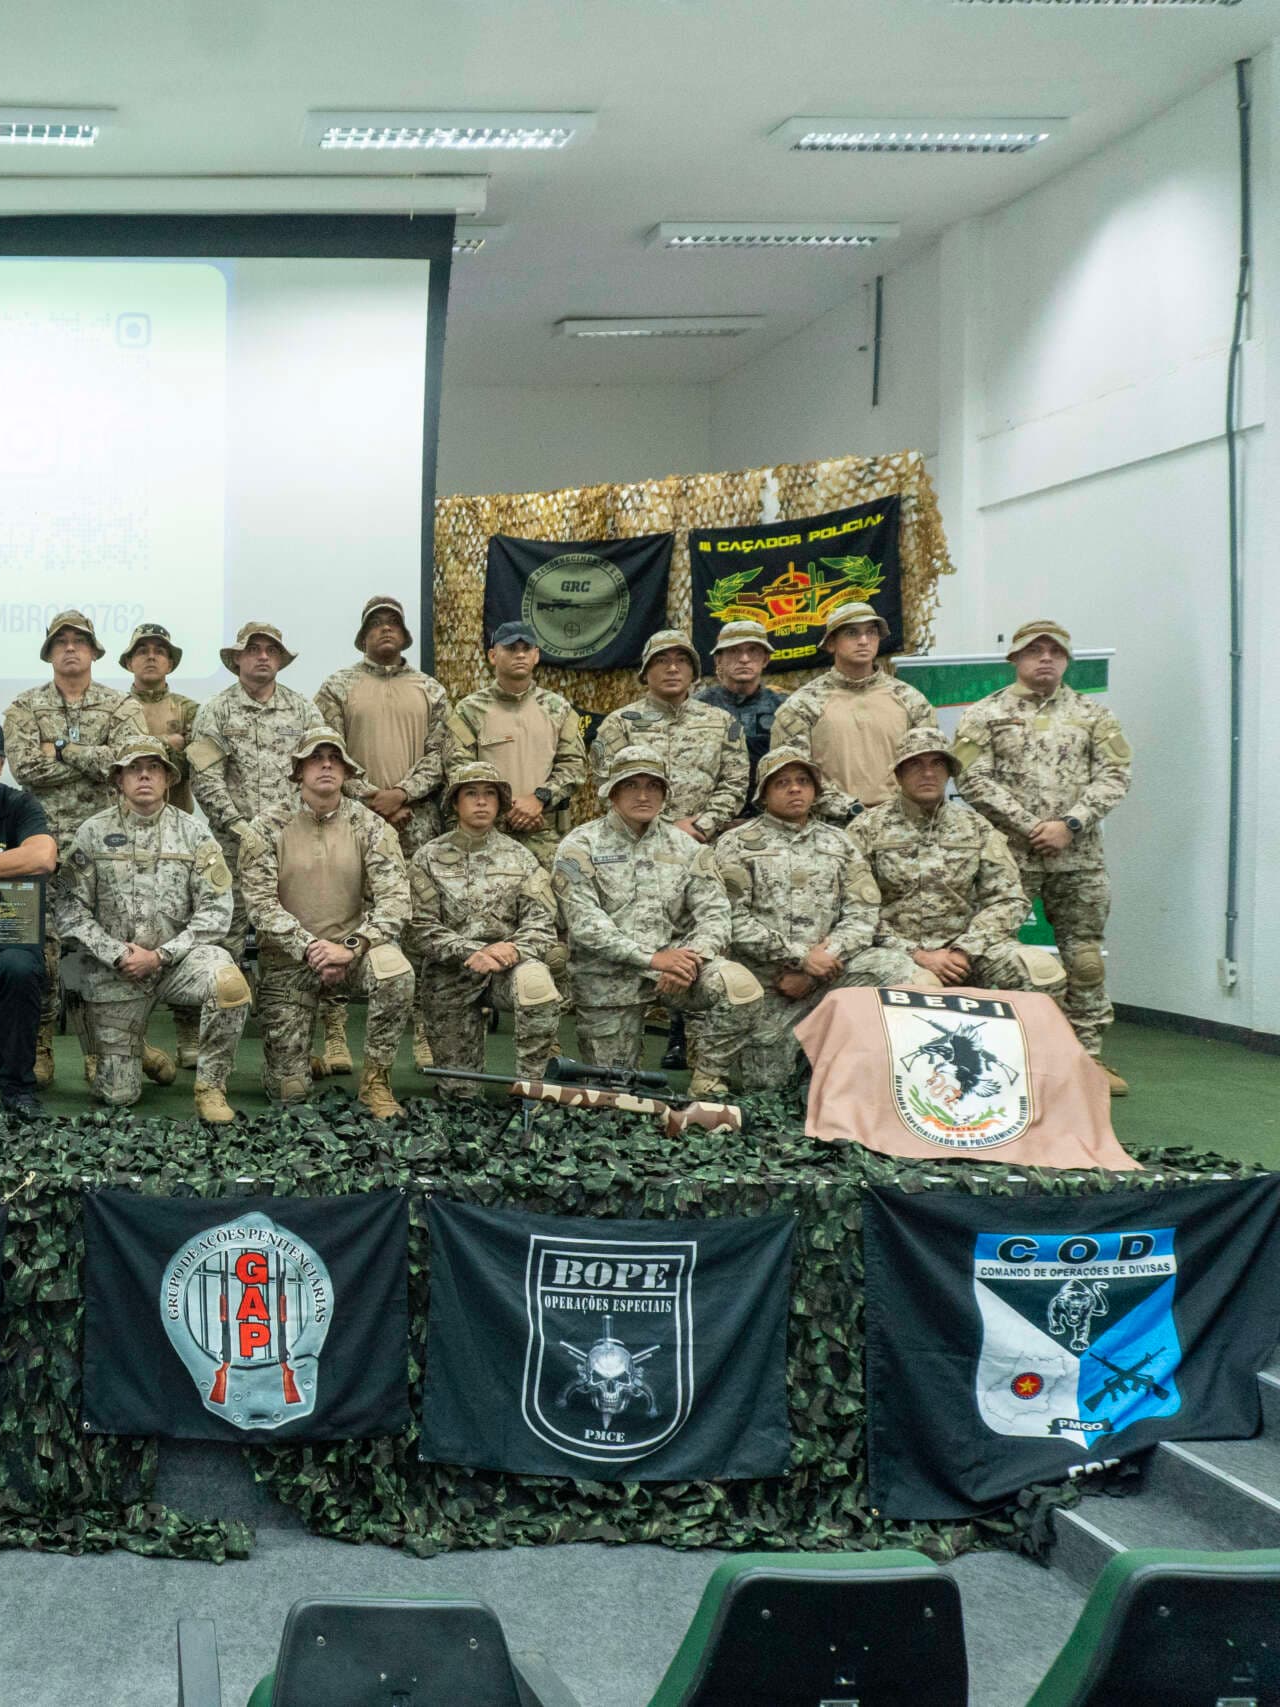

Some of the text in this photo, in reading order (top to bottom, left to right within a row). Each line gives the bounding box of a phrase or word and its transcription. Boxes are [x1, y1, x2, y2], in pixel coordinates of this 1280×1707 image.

[717, 534, 802, 553] CAÇADOR
[560, 580, 591, 592] GRC
[770, 645, 817, 661] 2025
[887, 990, 1005, 1017] BEPI
[904, 1112, 955, 1146] ESPECIALIZADO
[970, 1124, 1019, 1146] POLICIAMENTO
[996, 1232, 1156, 1265] COD
[167, 1228, 327, 1324] GRUPO DE AÇÕES PENITENCIÁRIAS
[551, 1258, 670, 1289] BOPE
[980, 1266, 1031, 1277] COMANDO
[1034, 1267, 1047, 1277] DE
[1112, 1265, 1127, 1275] DE
[1128, 1262, 1171, 1274] DIVISAS
[234, 1251, 271, 1358] GAP
[544, 1295, 672, 1314] OPERAÇÕES ESPECIAIS
[1058, 1419, 1104, 1431] PMGO
[583, 1428, 625, 1443] PMCE
